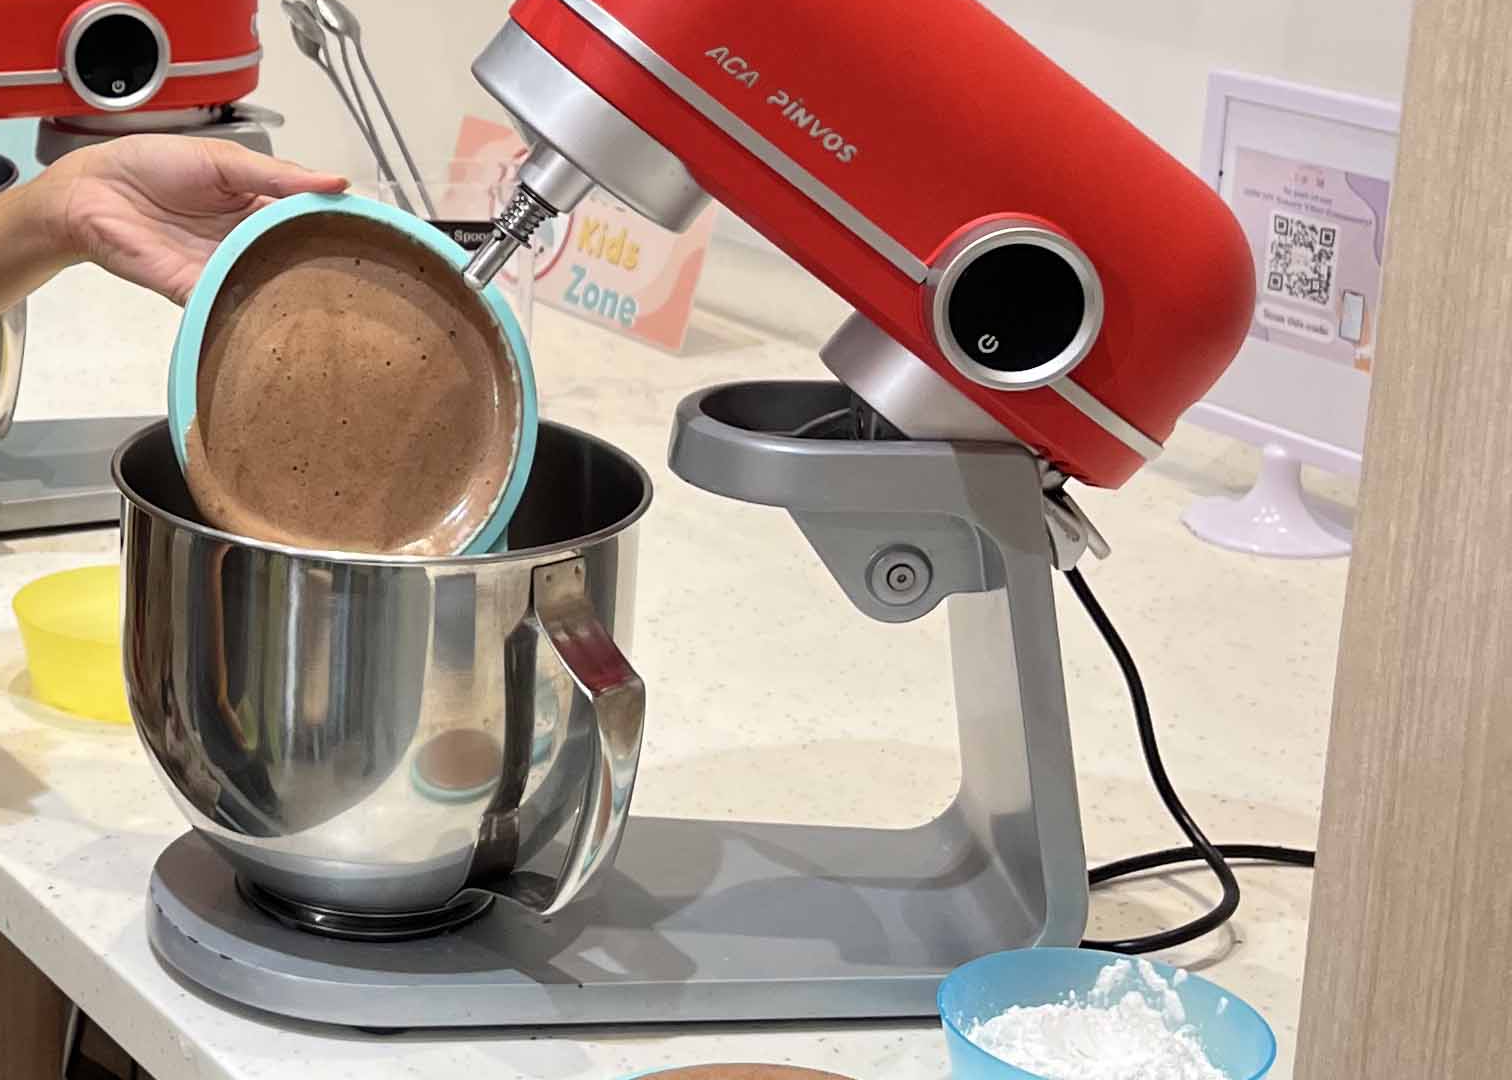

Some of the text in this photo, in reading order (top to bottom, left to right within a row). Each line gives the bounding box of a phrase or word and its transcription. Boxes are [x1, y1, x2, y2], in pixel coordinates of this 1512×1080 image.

[704, 45, 760, 88] ACA
[577, 216, 640, 270] Kids
[564, 265, 637, 326] Zone
